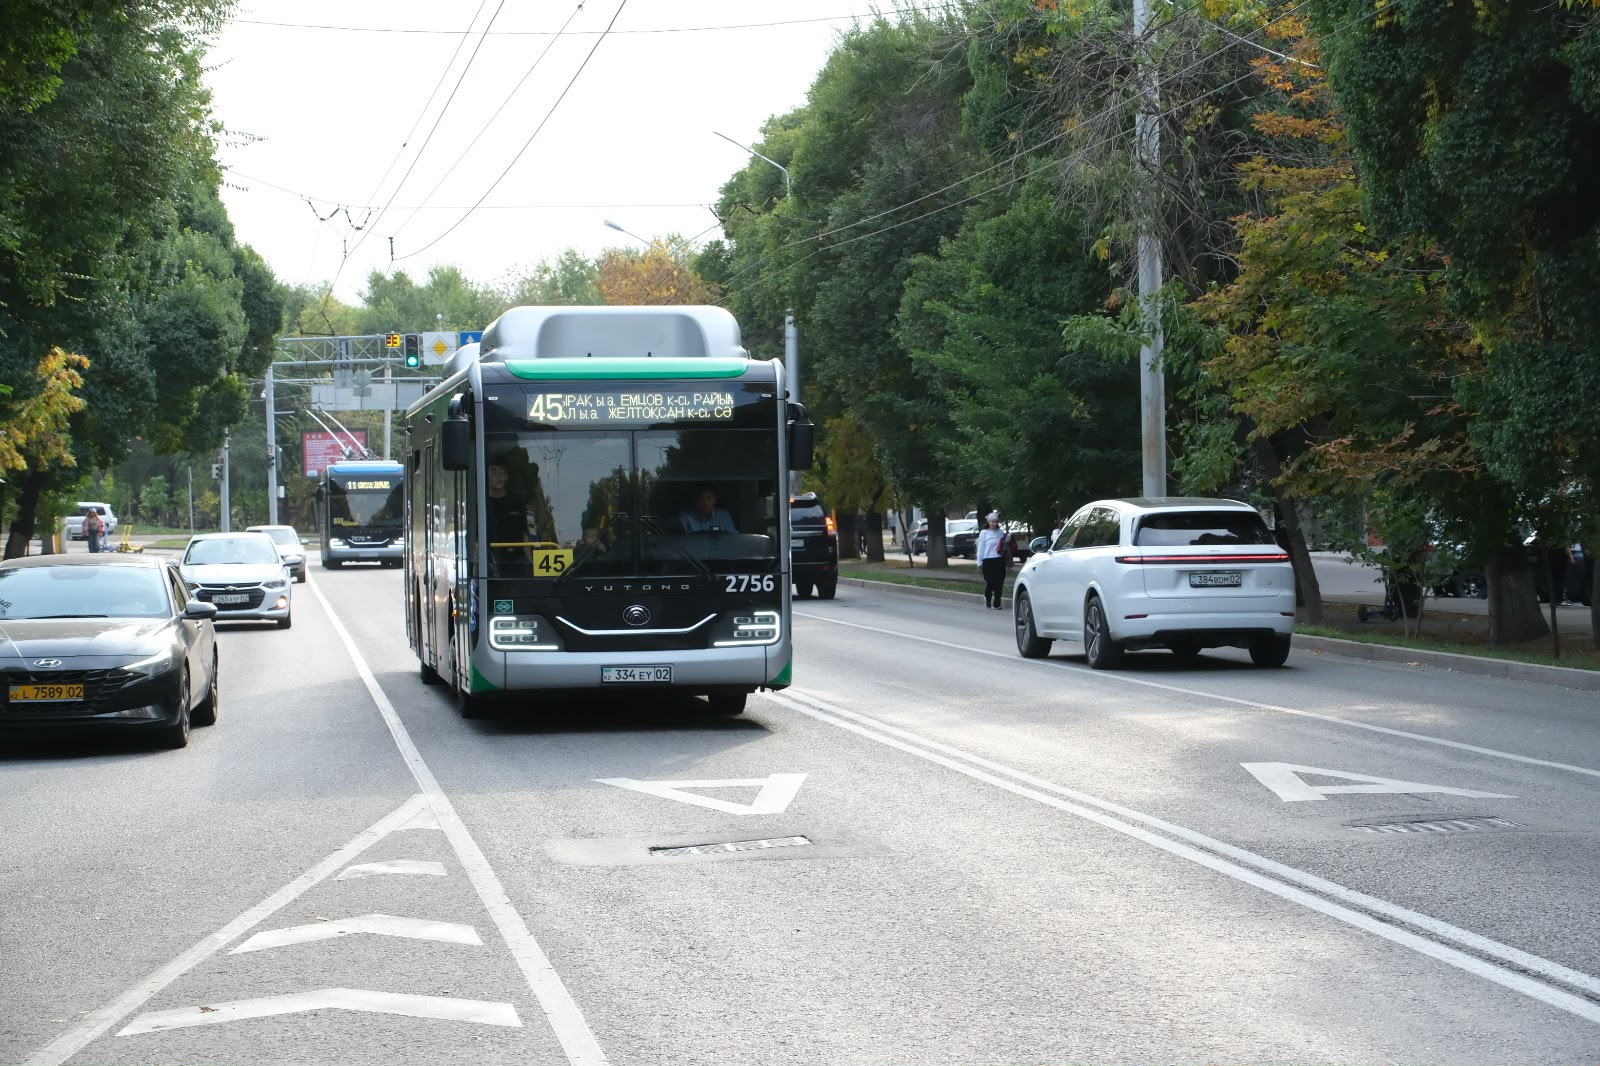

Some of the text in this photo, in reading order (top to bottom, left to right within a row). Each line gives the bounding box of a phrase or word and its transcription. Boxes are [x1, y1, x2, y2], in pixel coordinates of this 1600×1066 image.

[620, 394, 663, 406] ЕМЦОВ
[529, 394, 563, 421] 45
[609, 407, 684, 420] ЖЕЛТОҚСАН
[538, 554, 566, 573] 45
[725, 575, 775, 593] 2756
[1230, 574, 1240, 584] 02
[584, 584, 690, 592] YUTONG
[615, 669, 636, 680] 334
[639, 671, 652, 680] EY
[655, 668, 669, 680] 02
[33, 686, 63, 699] 7589
[67, 686, 83, 698] 02
